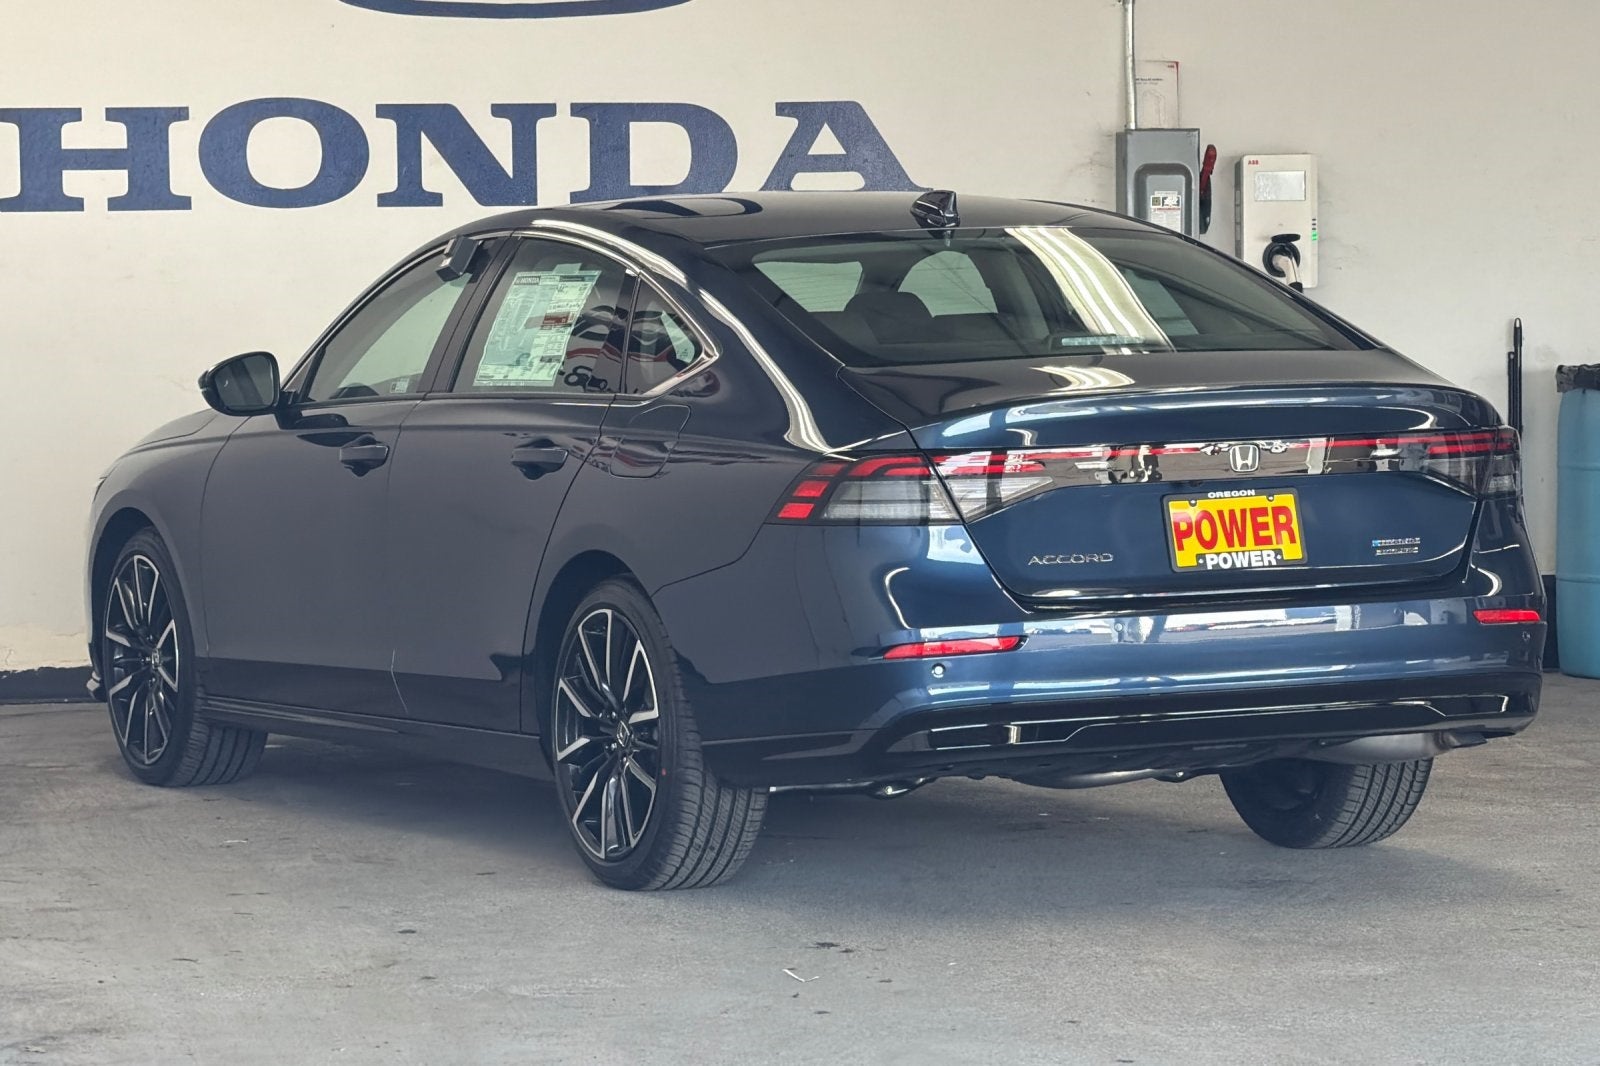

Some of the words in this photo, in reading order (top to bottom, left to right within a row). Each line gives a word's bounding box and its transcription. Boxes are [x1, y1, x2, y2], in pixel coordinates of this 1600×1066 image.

[0, 97, 933, 213] HONDA
[1207, 489, 1255, 499] OREGON
[1172, 505, 1297, 551] POWER
[1027, 553, 1114, 566] ACCORD
[1205, 549, 1278, 570] POWER
